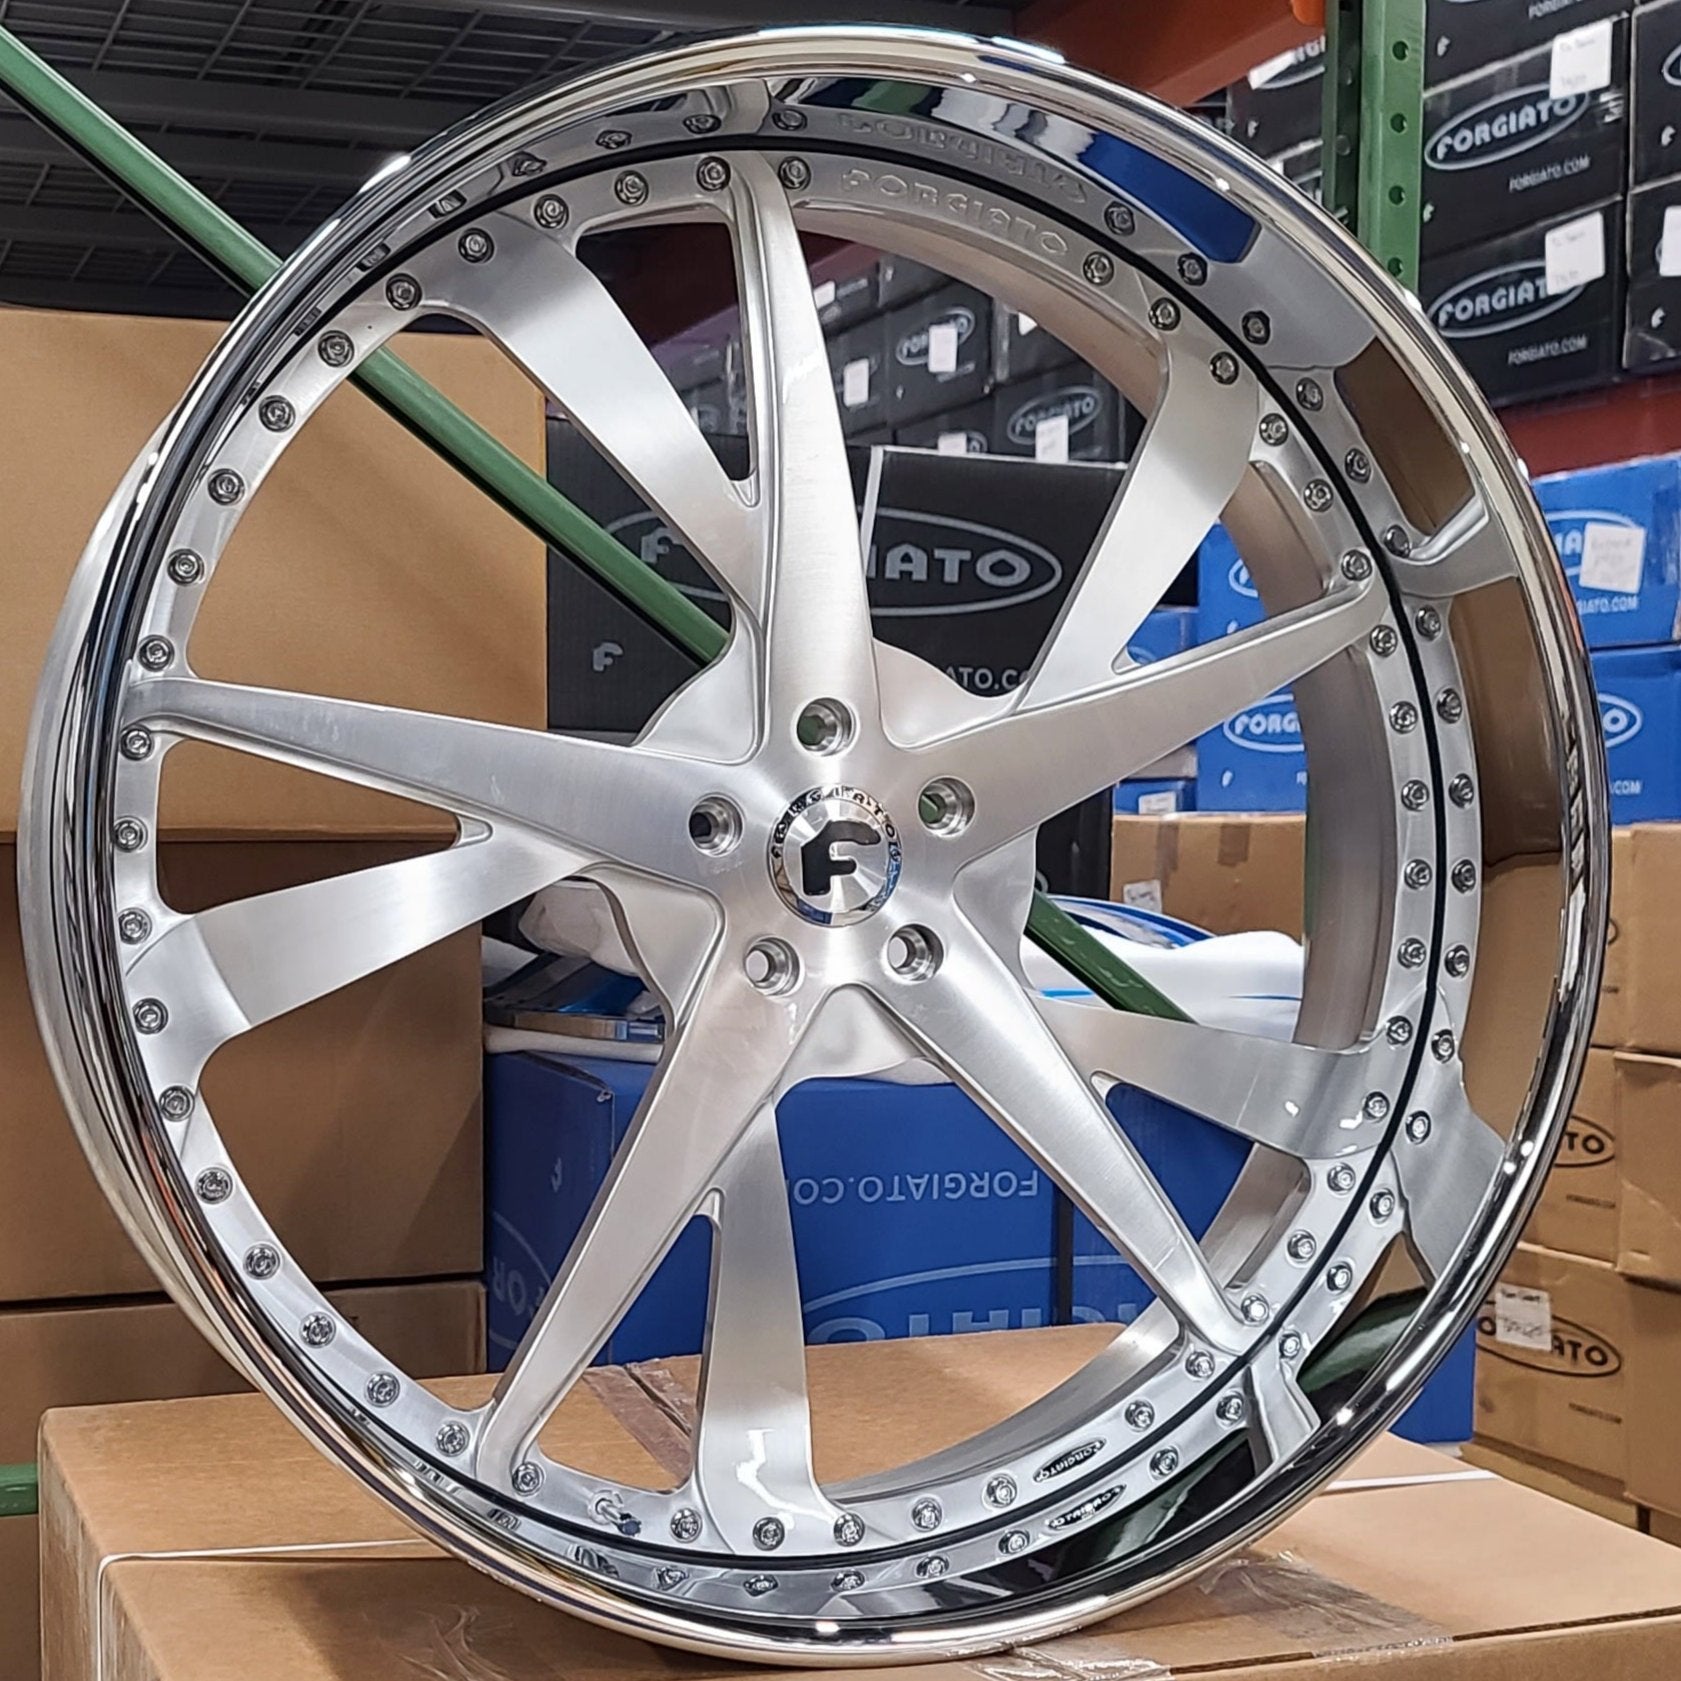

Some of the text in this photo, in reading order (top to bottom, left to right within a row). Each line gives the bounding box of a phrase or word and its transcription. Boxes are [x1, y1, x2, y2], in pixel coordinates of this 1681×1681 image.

[1436, 97, 1577, 160] FORGIATO
[1509, 154, 1590, 193] FORGIATO.COM
[842, 169, 1068, 254] FORGIATO
[1438, 278, 1550, 327] FORGIAT
[1507, 334, 1587, 366] FORGIATO.COM
[786, 1170, 1039, 1205] FORGIATO.CO
